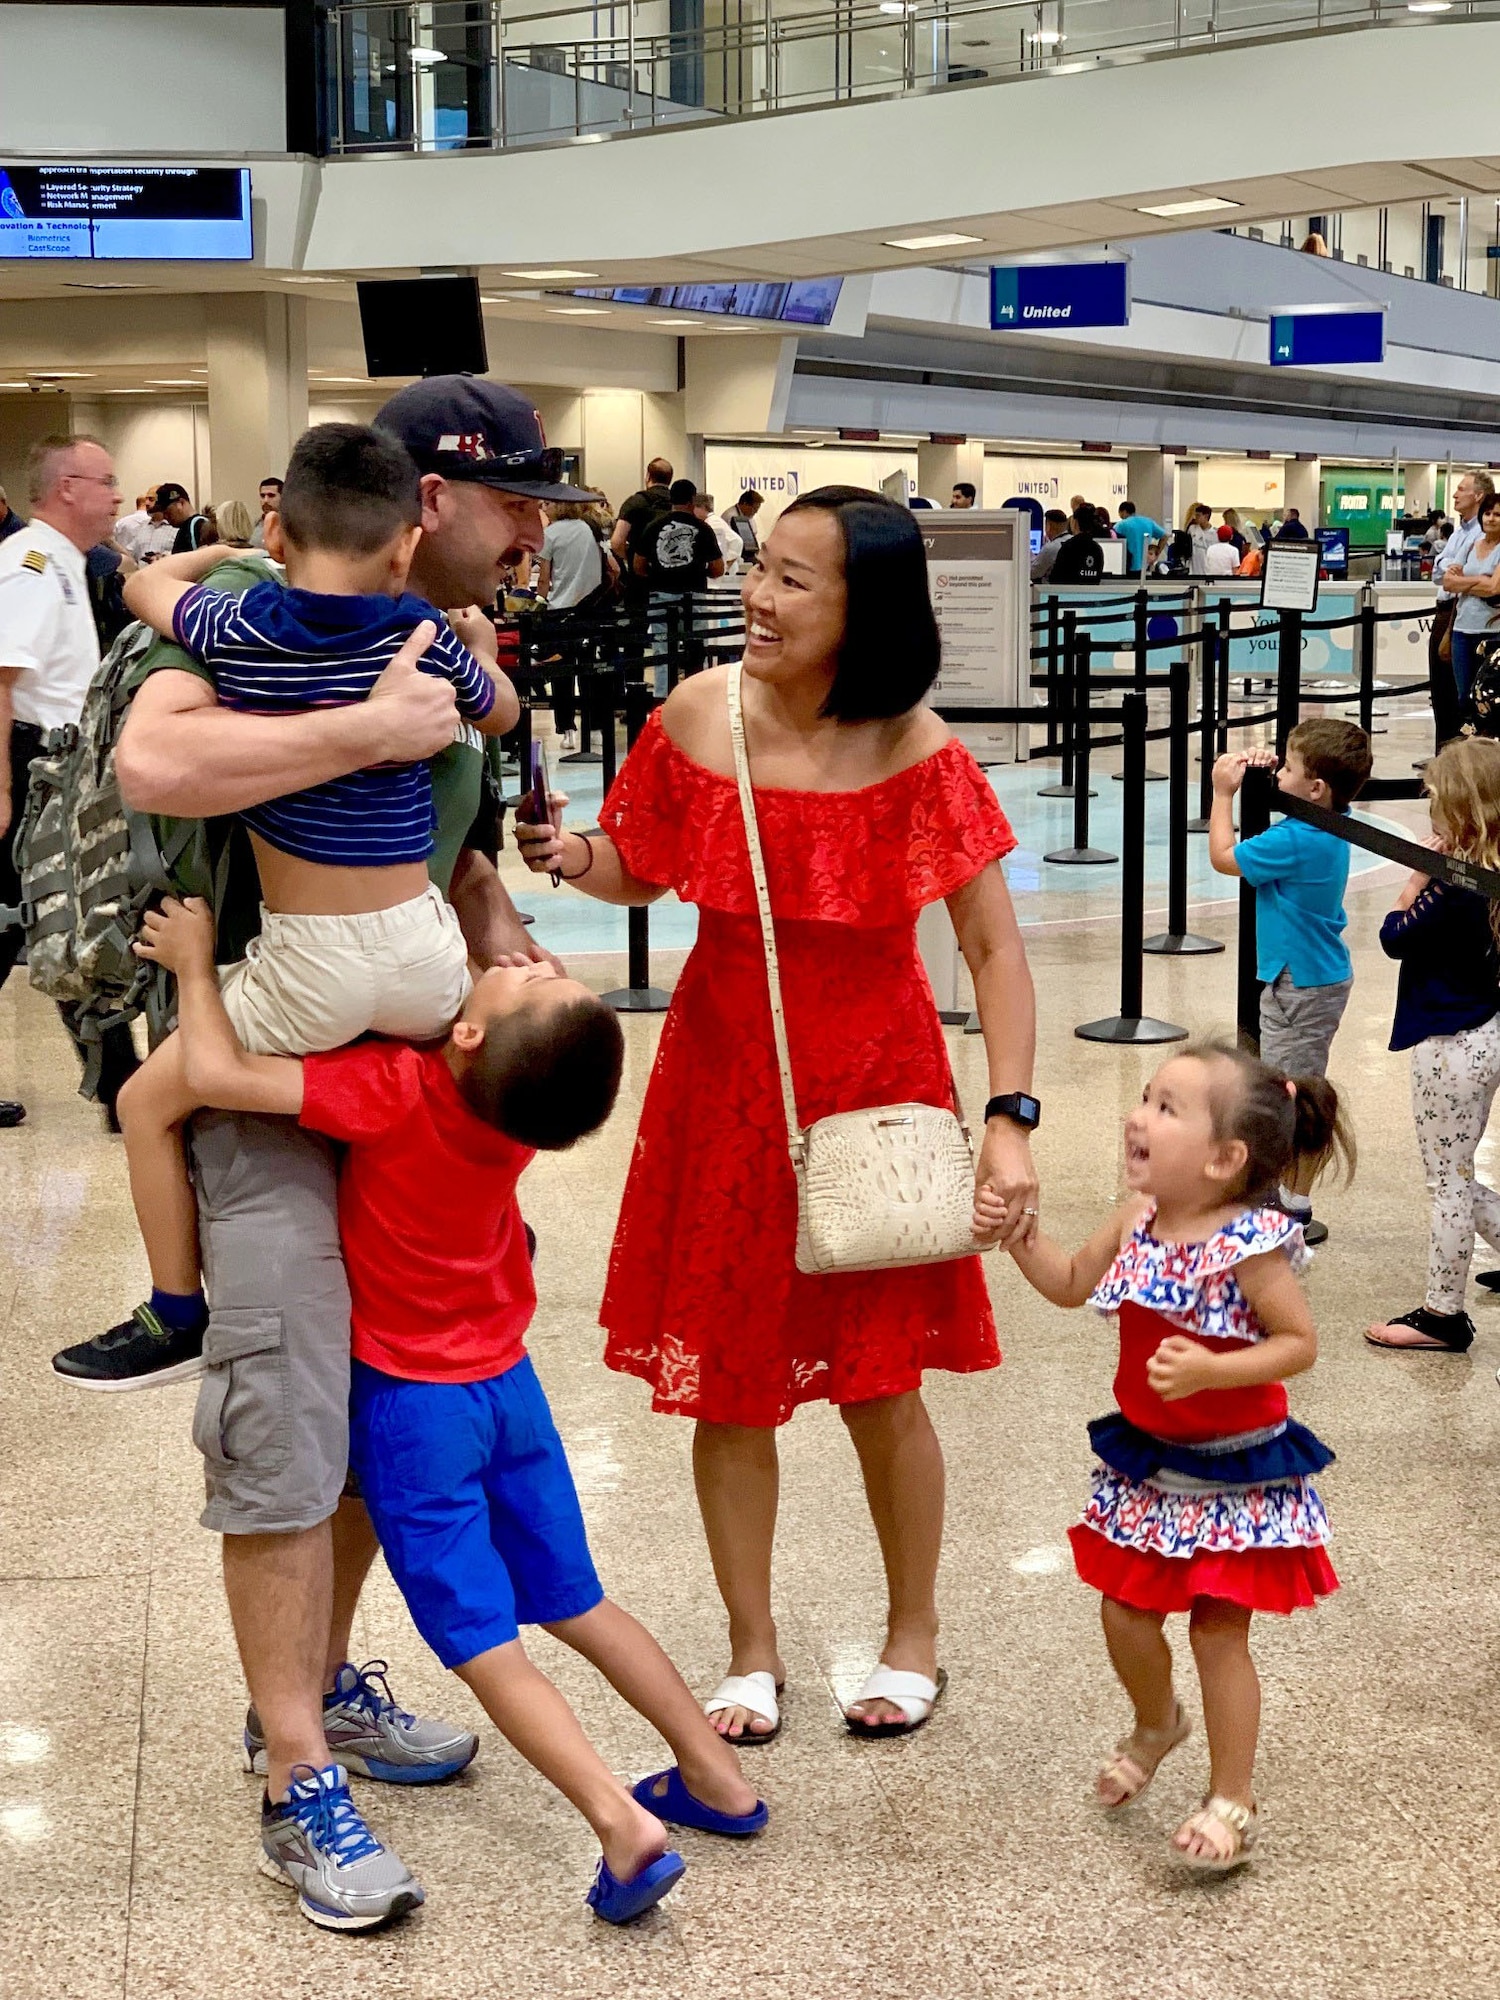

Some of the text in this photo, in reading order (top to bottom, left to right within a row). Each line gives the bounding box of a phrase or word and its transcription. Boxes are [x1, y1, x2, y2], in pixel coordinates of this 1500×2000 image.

[46, 183, 77, 191] Layered
[112, 184, 143, 193] Strategy
[47, 192, 79, 200] Network
[28, 234, 71, 242] Biometrics
[1023, 305, 1071, 318] United
[740, 476, 785, 490] UNITED
[1018, 482, 1050, 494] UNITED
